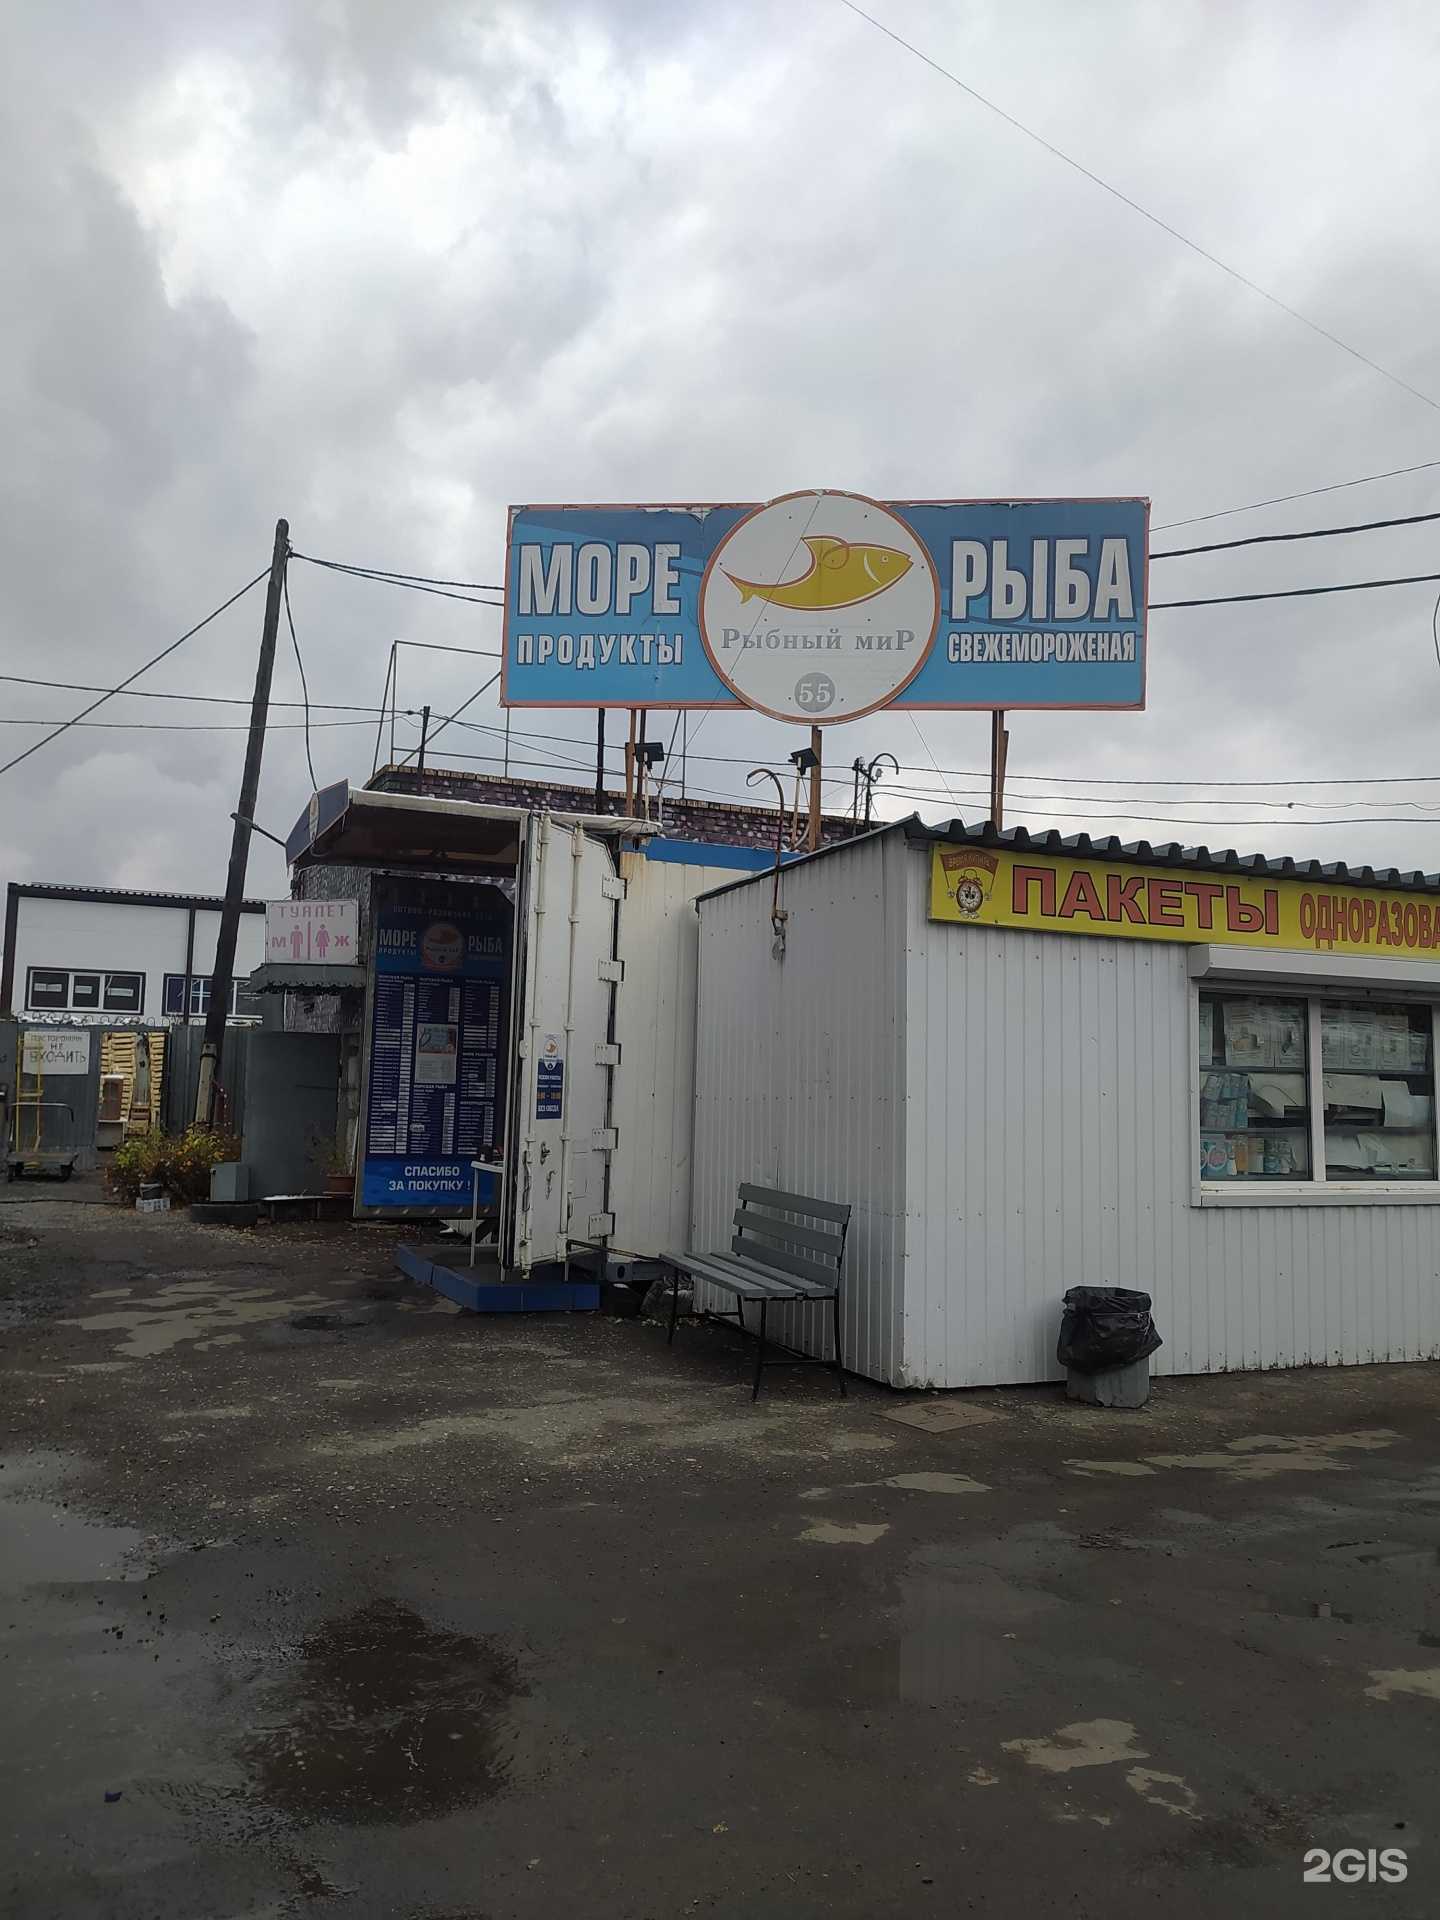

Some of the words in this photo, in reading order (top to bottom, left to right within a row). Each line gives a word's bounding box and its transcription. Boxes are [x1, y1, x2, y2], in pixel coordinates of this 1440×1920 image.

[518, 542, 684, 616] МОРЕ
[950, 537, 1136, 621] РЫБА
[721, 628, 843, 650] Рыбный
[947, 630, 1136, 664] СВЕЖЕМОРОЖЕНАЯ
[516, 633, 684, 667] ПРОДУКТЫ
[800, 683, 831, 703] 55
[1011, 864, 1280, 936] ПАКЕТЫ
[279, 904, 345, 918] ТУАЛЕТ
[271, 936, 286, 948] М
[334, 935, 350, 947] Ж
[379, 928, 417, 948] МОРЕ
[467, 935, 503, 953] РЫБА
[404, 1166, 460, 1177] СПАСИБО
[388, 1180, 404, 1191] ЗА
[408, 1180, 463, 1191] ПОКУПКУ
